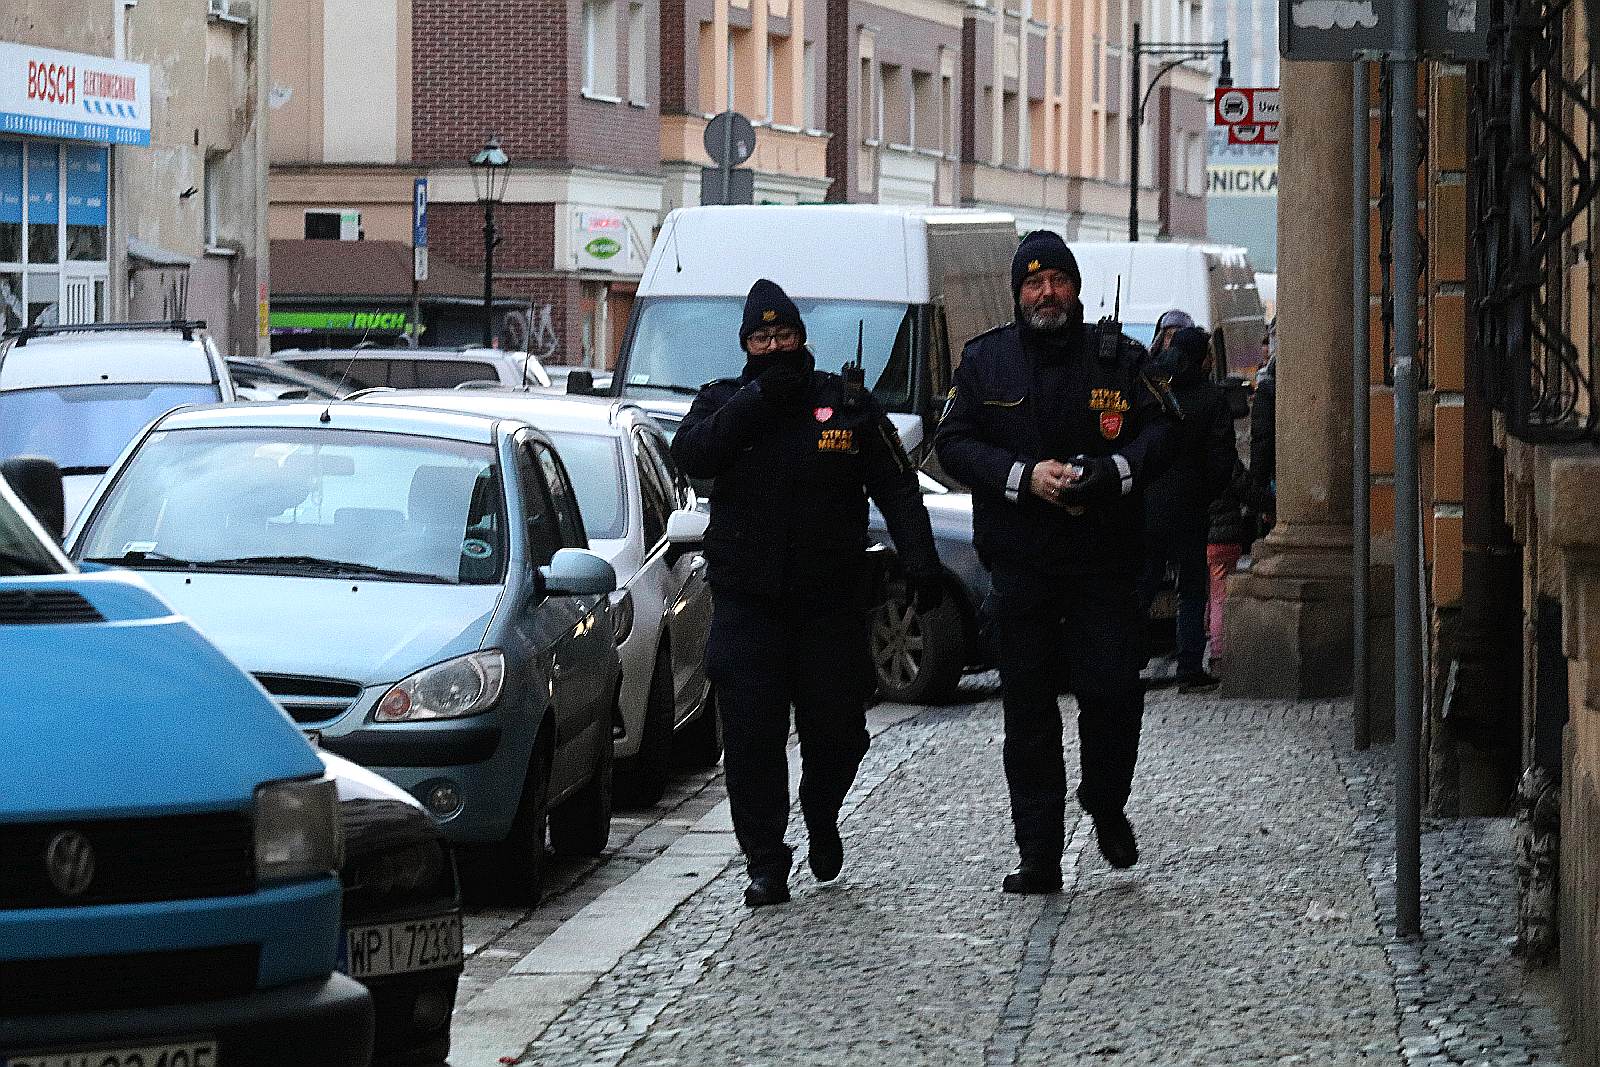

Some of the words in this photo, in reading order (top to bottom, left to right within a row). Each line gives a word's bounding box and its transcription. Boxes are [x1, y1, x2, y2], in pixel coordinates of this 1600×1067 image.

[28, 60, 76, 104] BOSCH
[417, 184, 427, 227] P
[353, 312, 406, 329] RUCH
[350, 927, 394, 973] WPI
